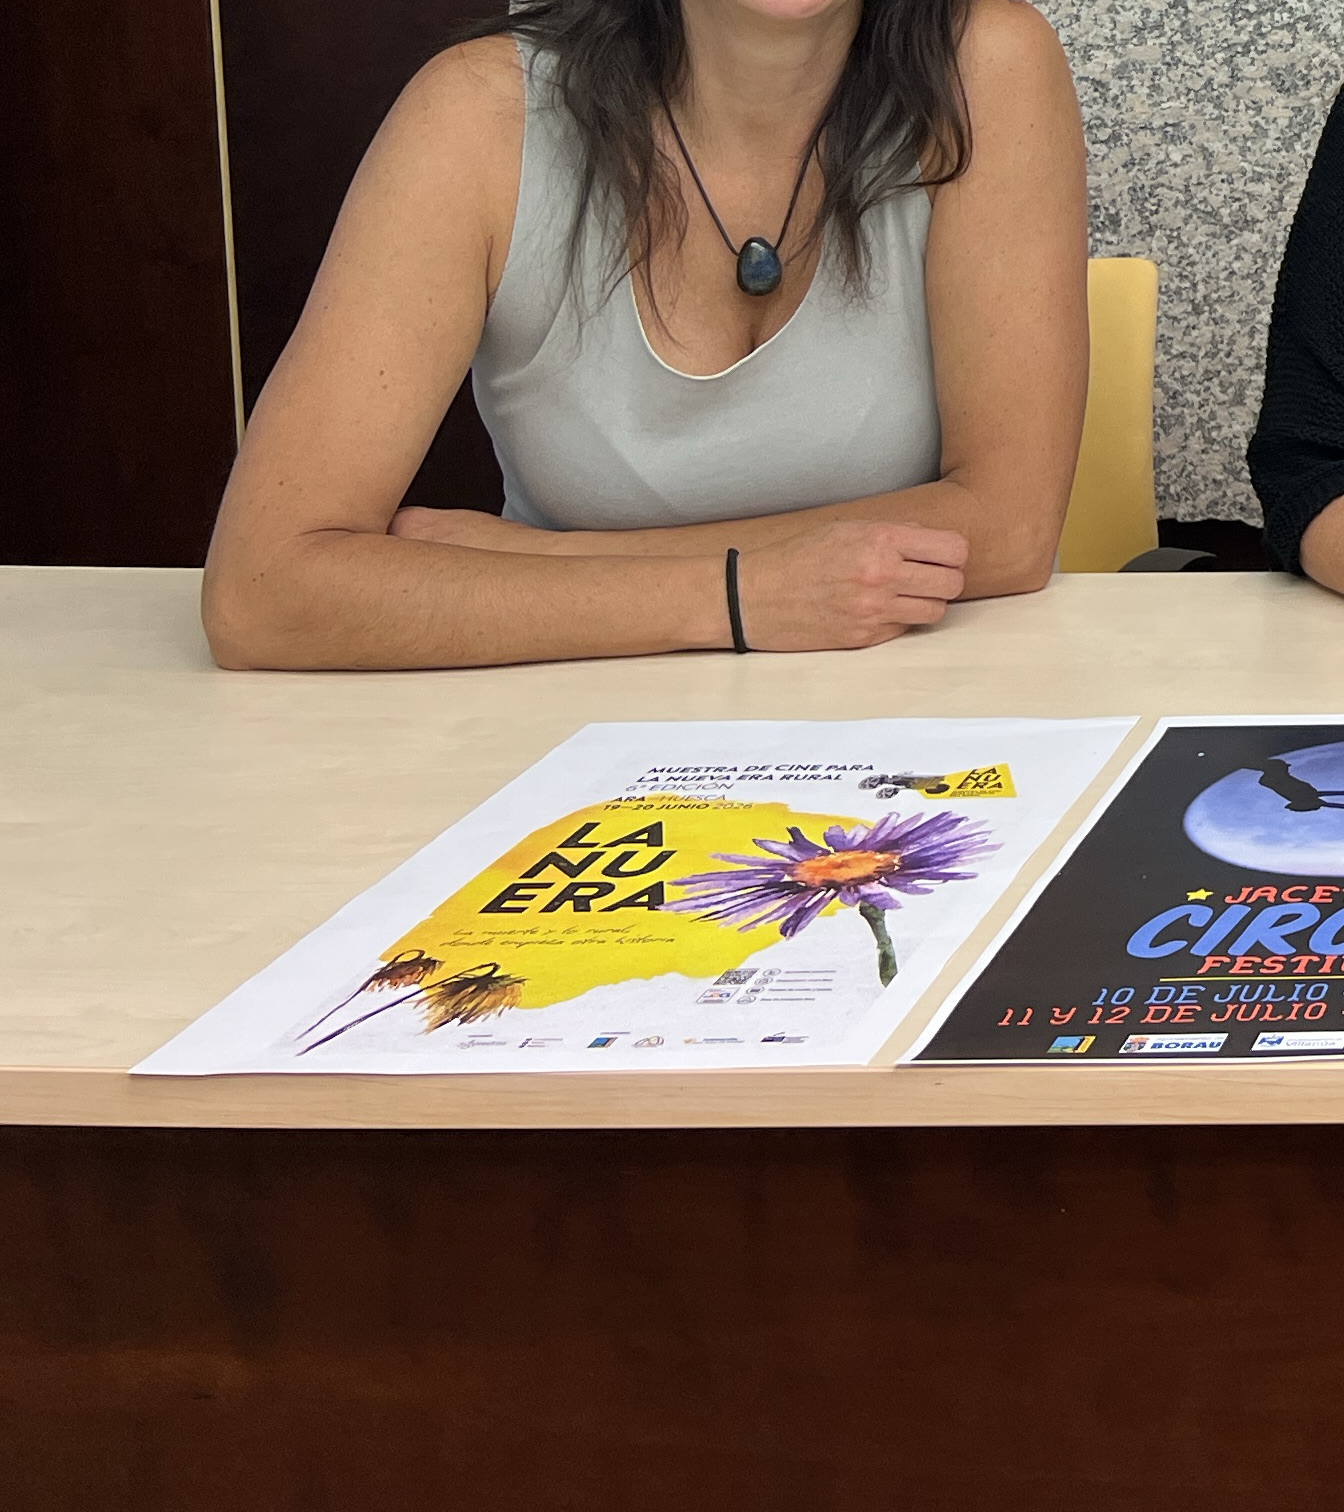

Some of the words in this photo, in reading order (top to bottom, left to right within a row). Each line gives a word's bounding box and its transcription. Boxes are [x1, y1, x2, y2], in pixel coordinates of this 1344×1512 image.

[744, 764, 772, 772] DE
[825, 763, 874, 771] PARA
[648, 781, 734, 791] EDICIÓN
[656, 803, 710, 811] JUNIO
[556, 821, 663, 848] LA
[518, 850, 677, 879] NU
[478, 880, 665, 914] ERA
[1091, 987, 1135, 1005] 10
[1144, 985, 1207, 1005] DE
[1213, 983, 1329, 1003] JULIO
[997, 1008, 1034, 1026] 11
[1049, 1006, 1077, 1024] Y
[1087, 1006, 1139, 1024] 12
[1139, 1005, 1202, 1024] DE
[1209, 1002, 1327, 1022] JULIO
[1150, 1041, 1222, 1050] BORAU
